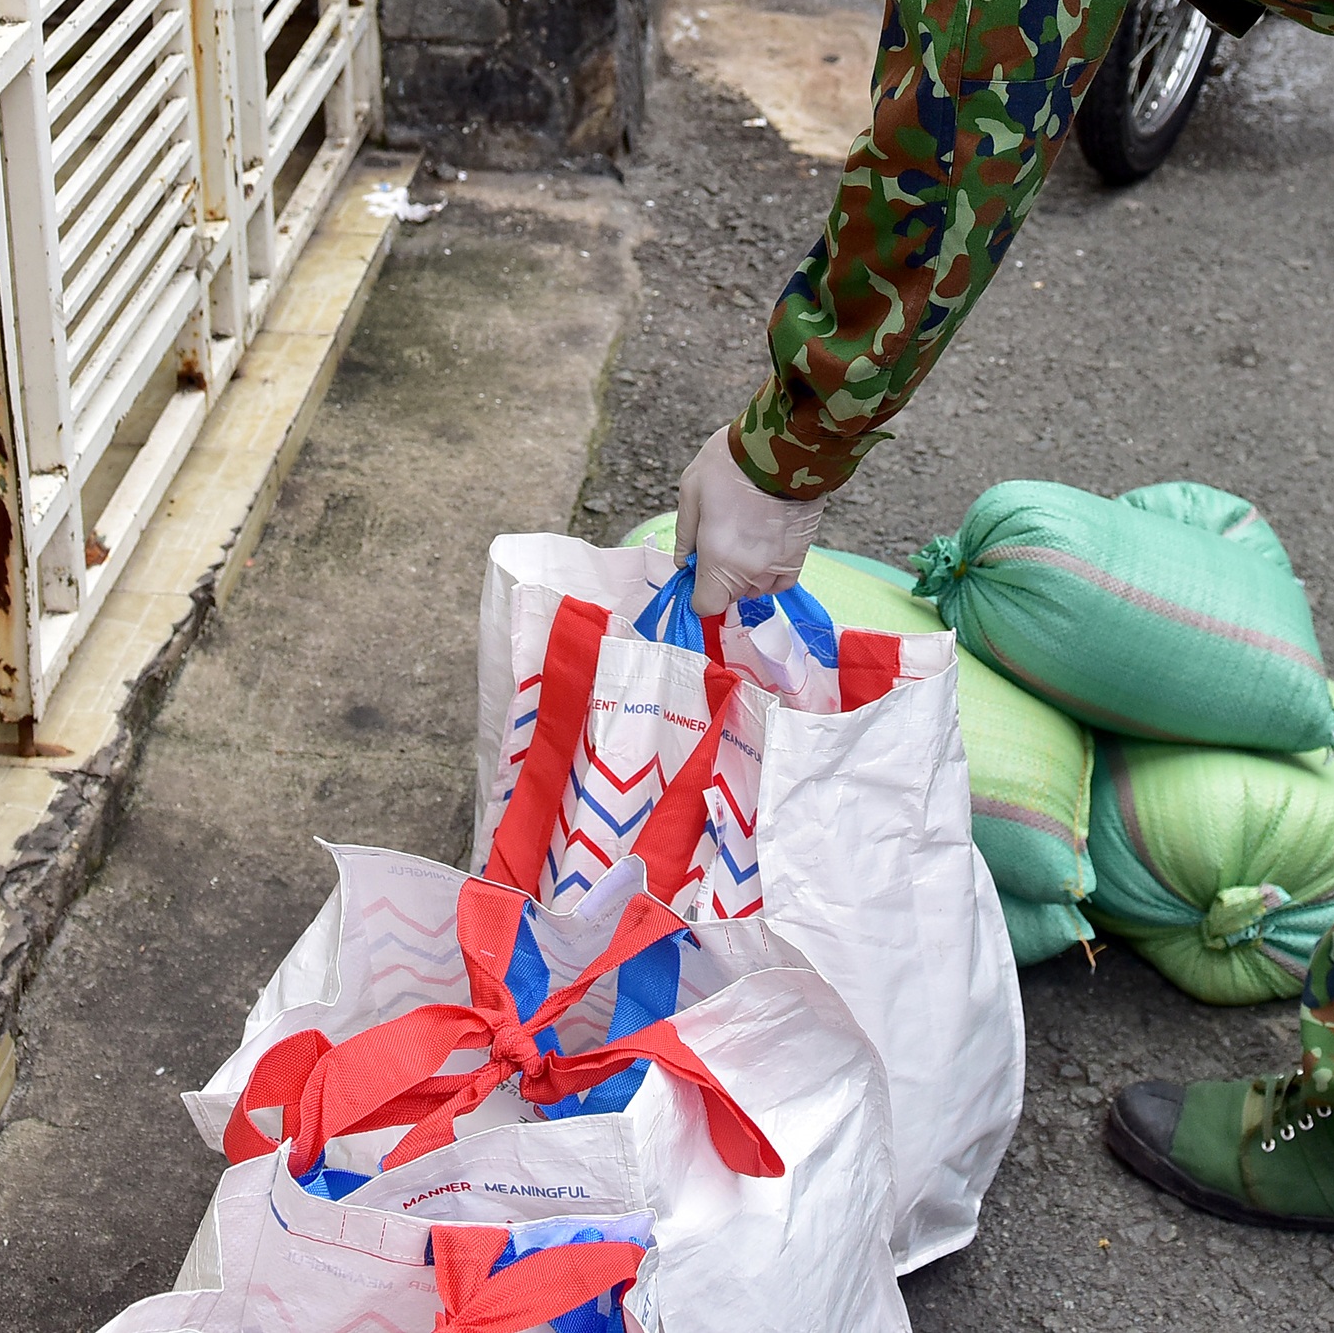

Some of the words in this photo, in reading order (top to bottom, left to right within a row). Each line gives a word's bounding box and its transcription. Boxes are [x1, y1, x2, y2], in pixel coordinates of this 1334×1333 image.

[593, 698, 617, 712] ENT
[623, 703, 660, 716] MORE
[663, 709, 707, 733] MANNER
[402, 1181, 472, 1210] MANNER
[484, 1182, 590, 1199] MEANINGFUL
